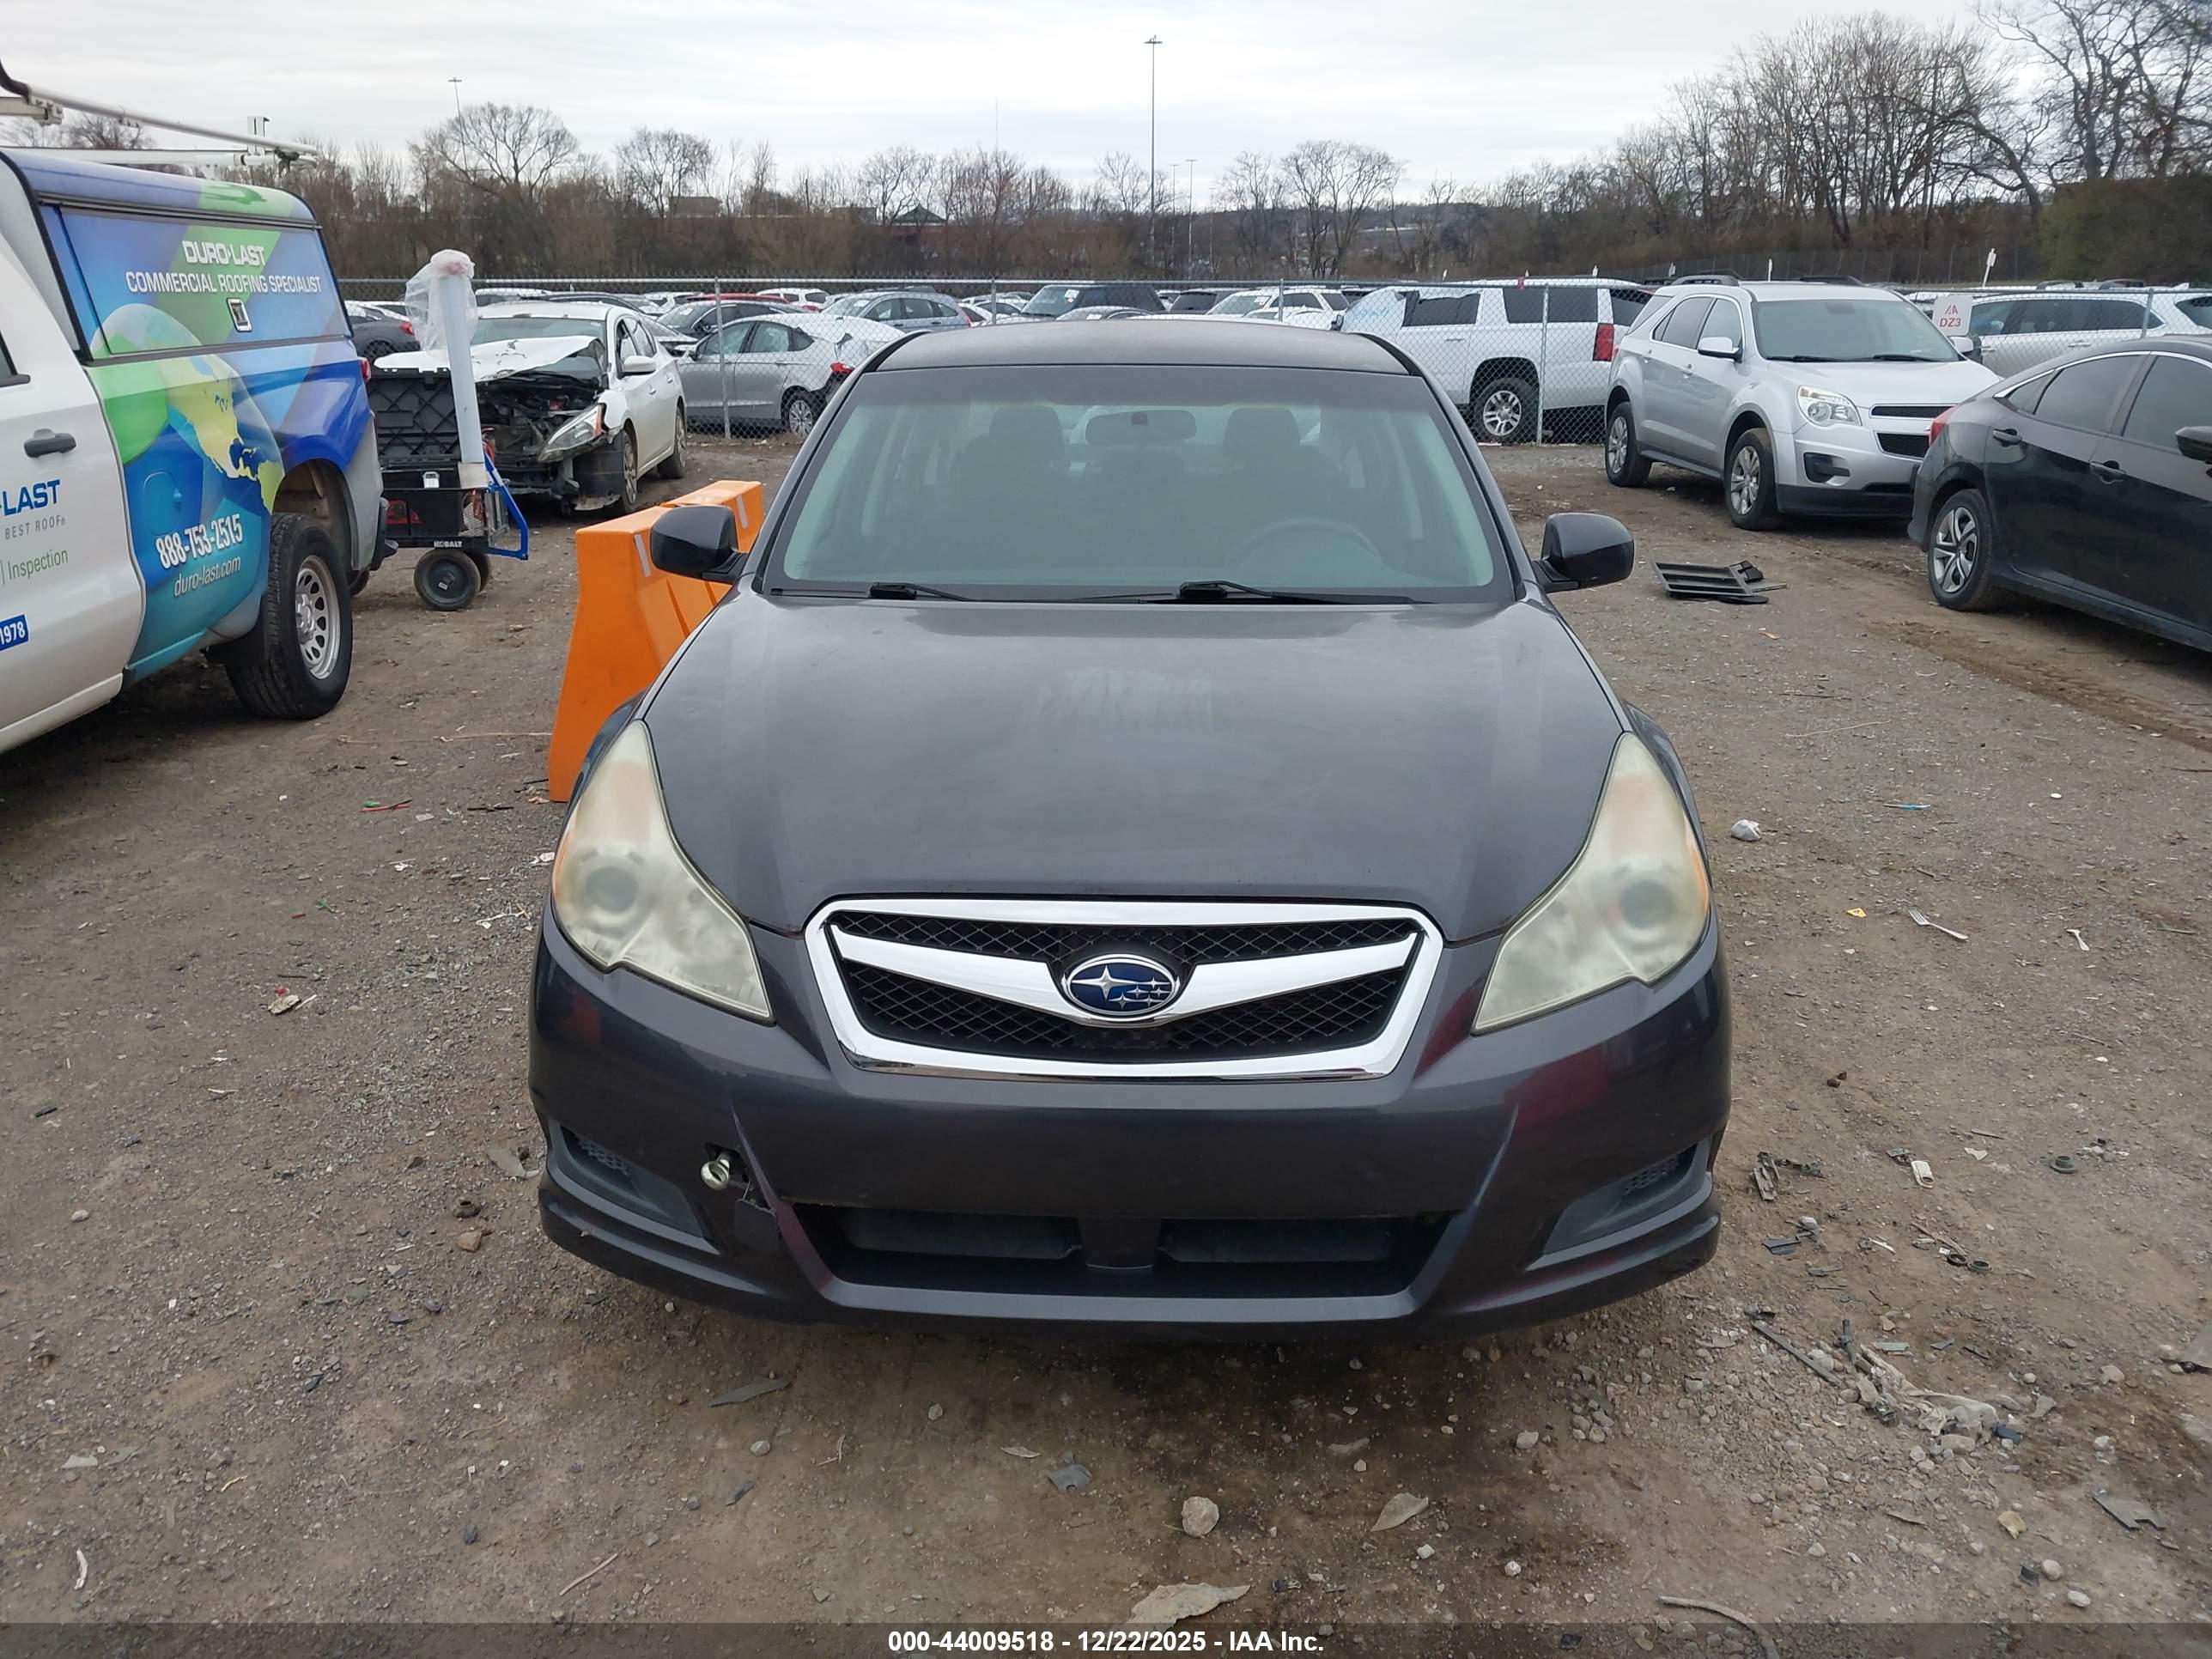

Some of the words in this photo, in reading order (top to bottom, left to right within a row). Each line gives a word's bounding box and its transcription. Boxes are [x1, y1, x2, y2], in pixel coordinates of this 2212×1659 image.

[125, 270, 218, 294] COMMERCIAL
[217, 274, 268, 294] ROOFING
[269, 275, 322, 294] SPECIALIST
[1940, 317, 1961, 327] DZ3
[5, 522, 30, 540] BEST
[155, 514, 243, 568] 888-753-2515
[8, 549, 69, 580] Inspection
[173, 556, 241, 597] duro-last.com
